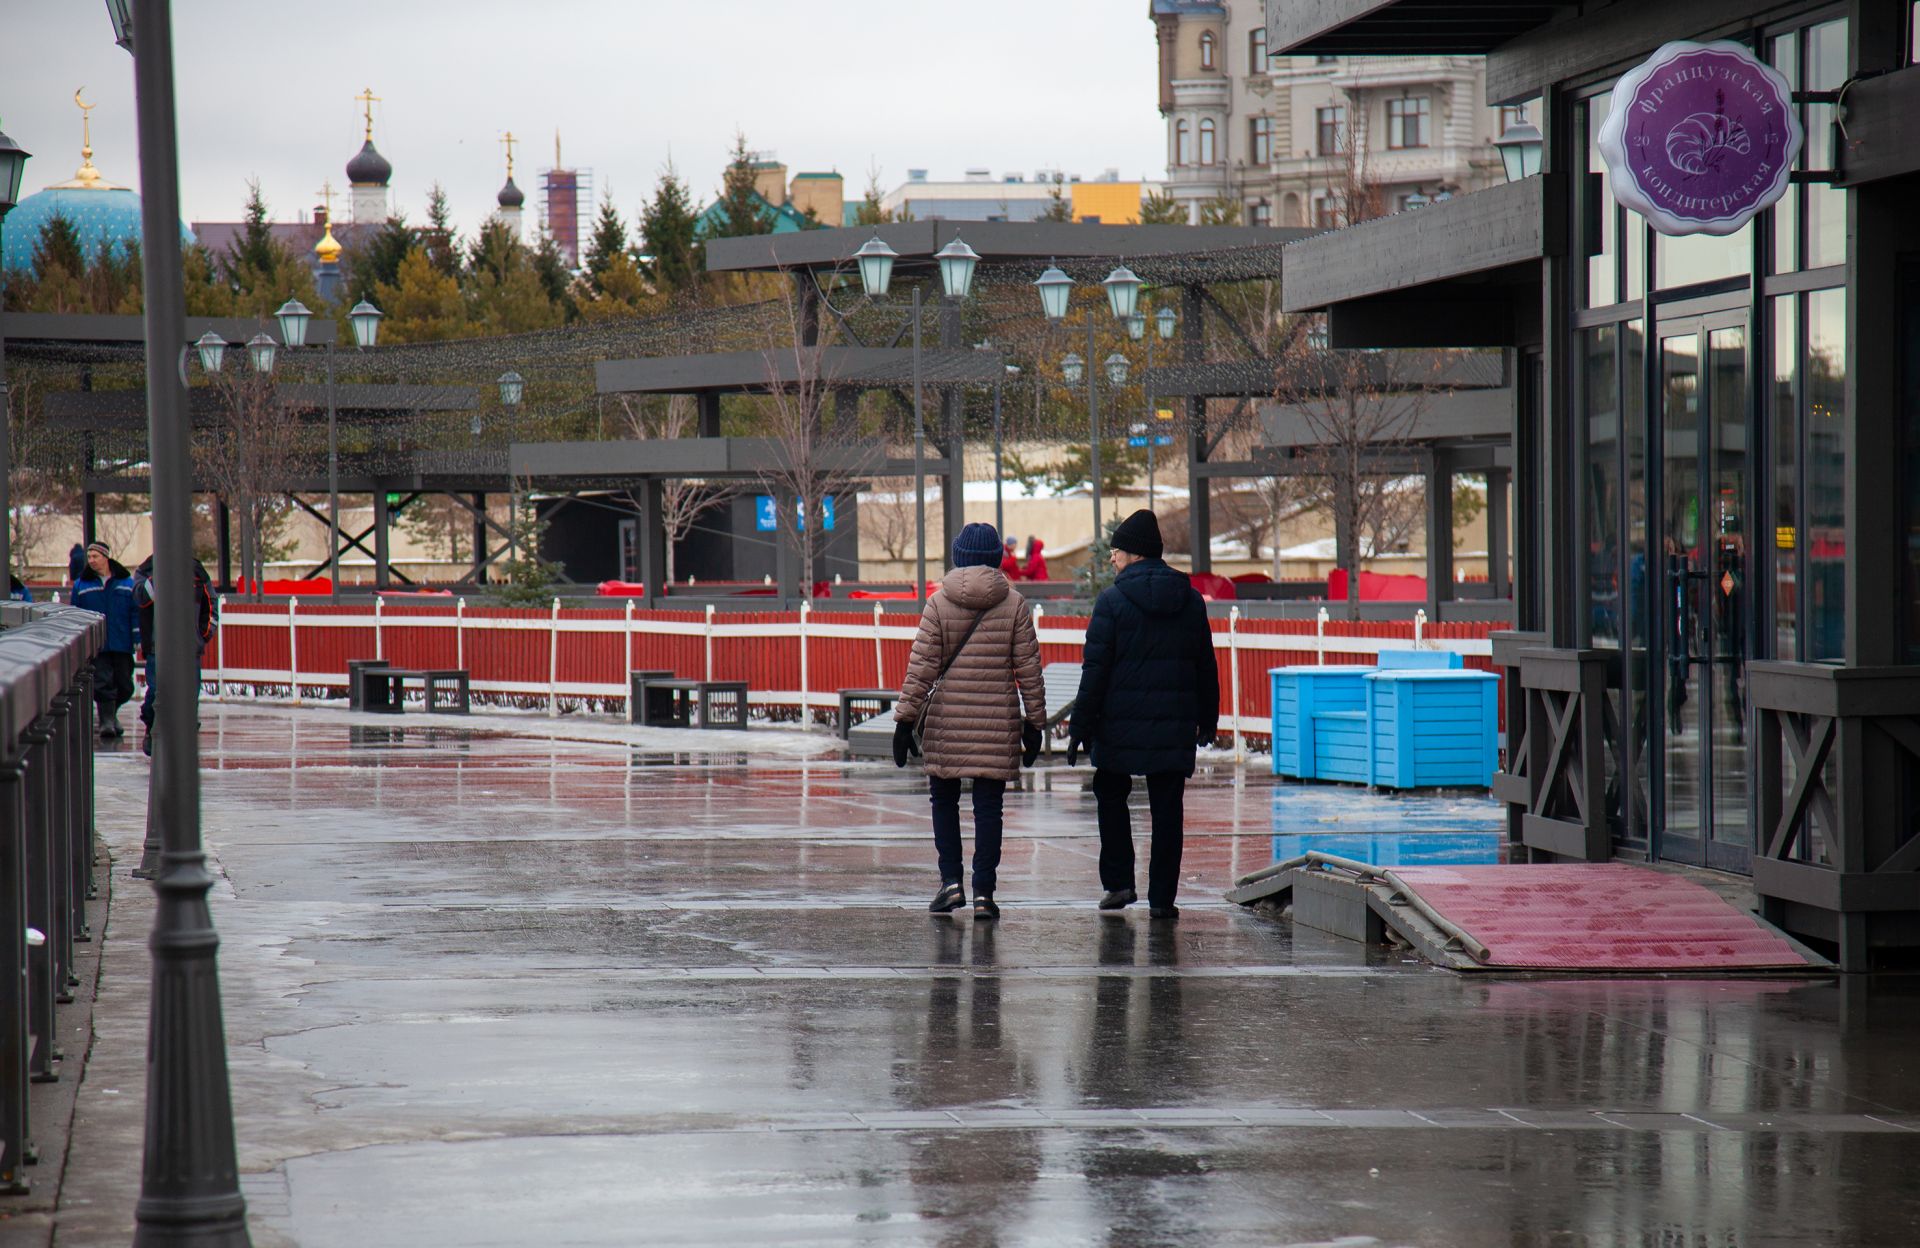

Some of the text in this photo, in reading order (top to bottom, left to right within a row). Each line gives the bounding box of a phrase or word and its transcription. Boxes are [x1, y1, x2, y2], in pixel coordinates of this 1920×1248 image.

[1639, 65, 1773, 115] французская
[1633, 135, 1650, 147] 20
[1764, 132, 1779, 145] 15
[1642, 161, 1772, 211] кондитерская
